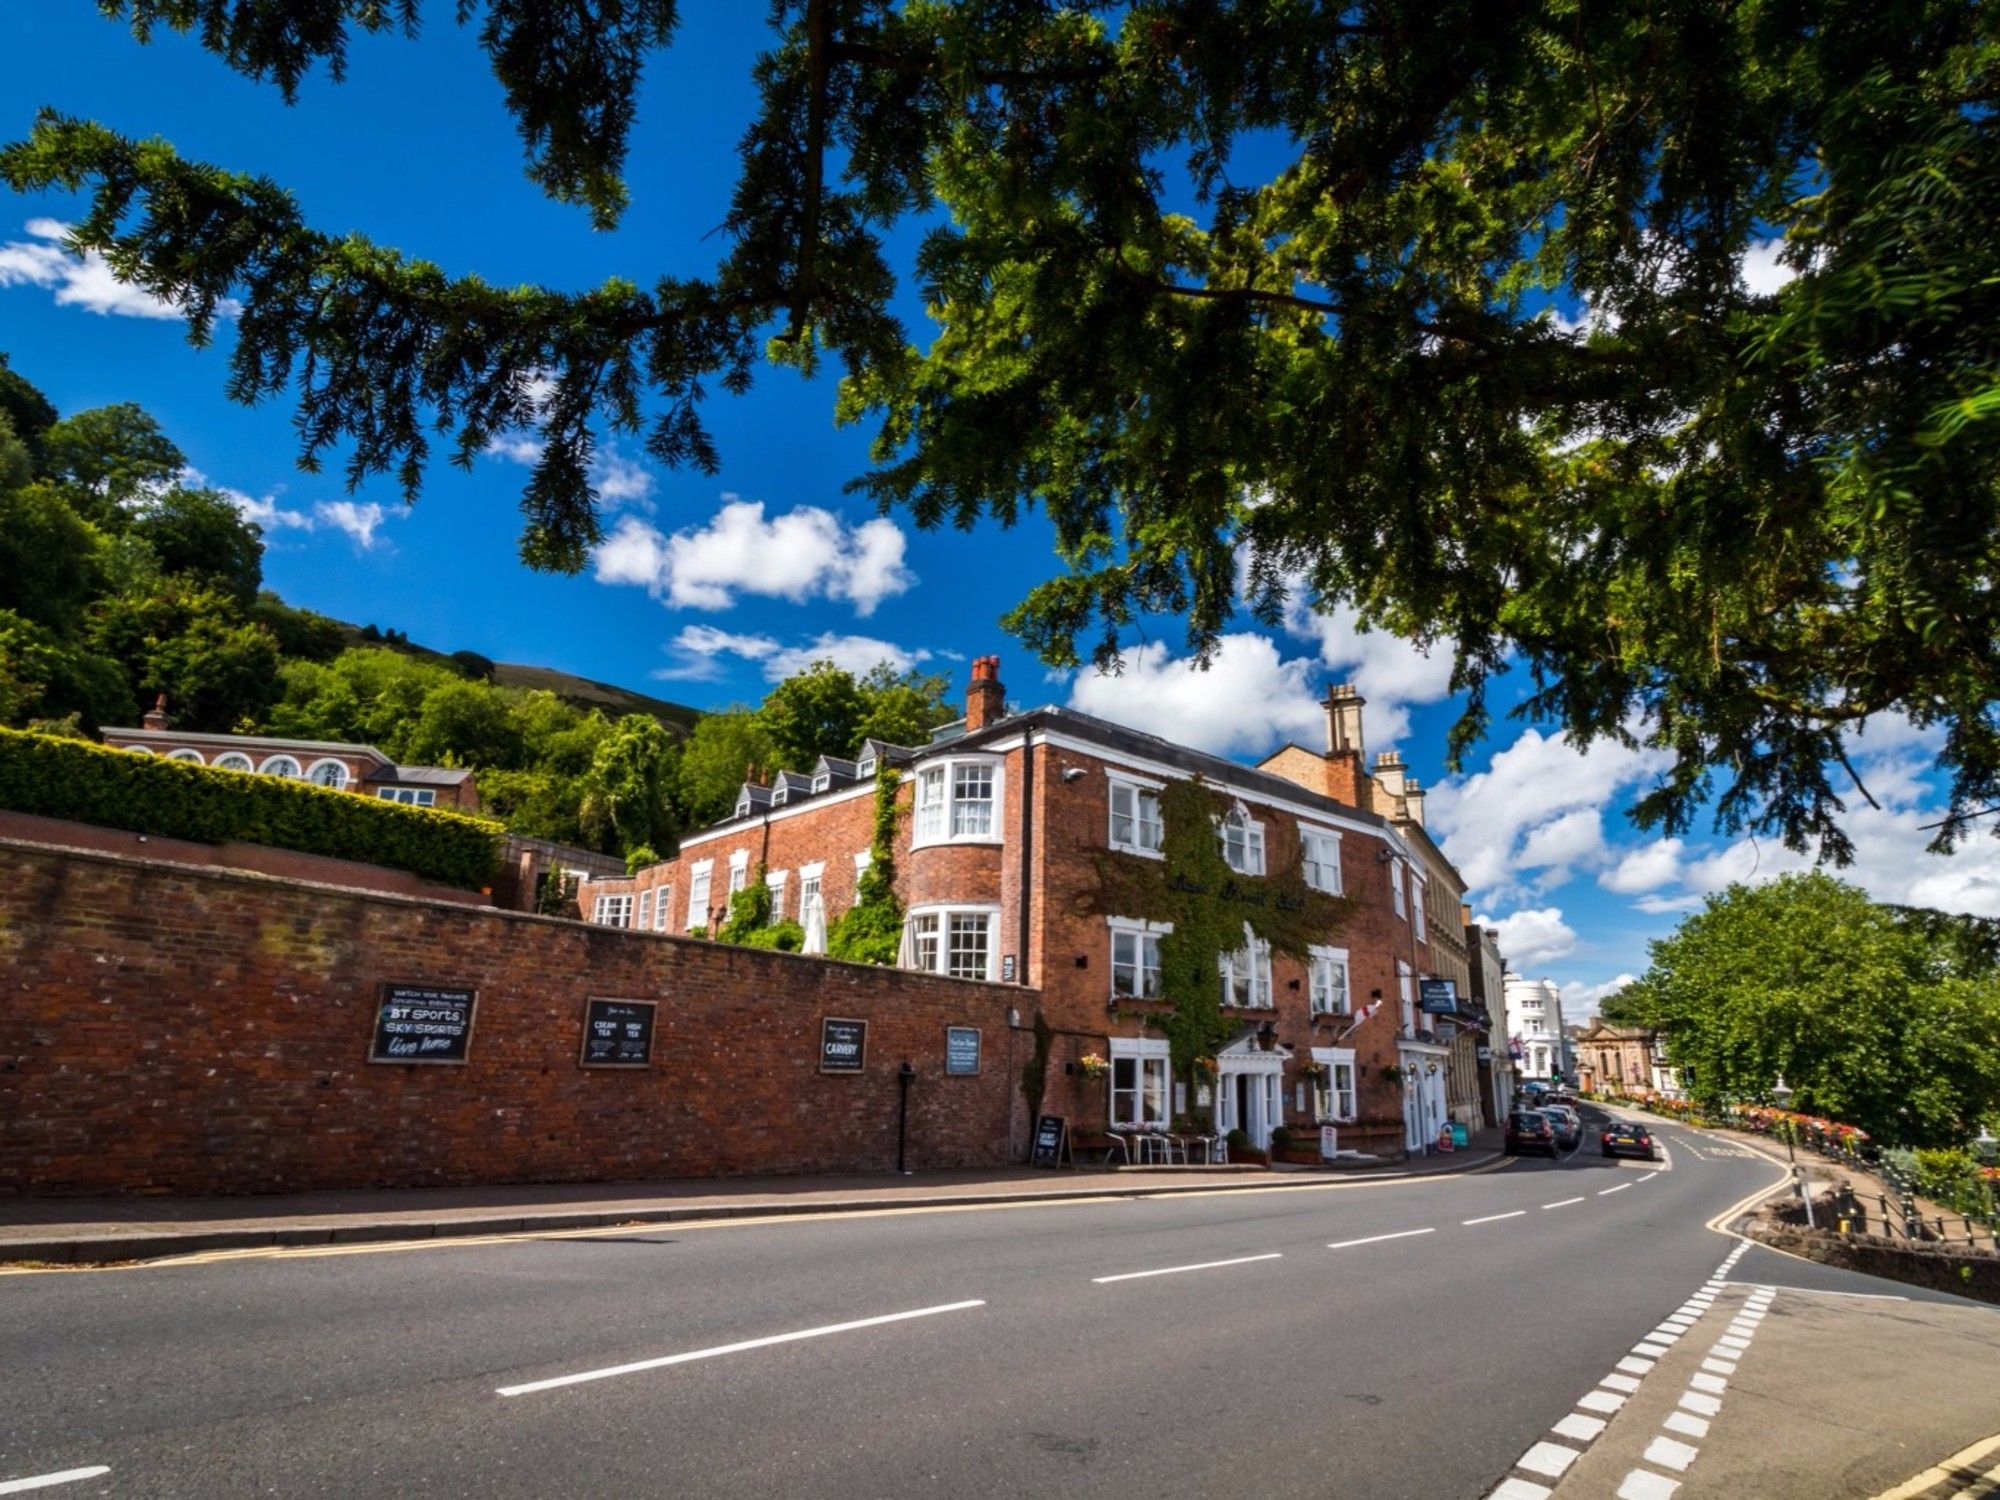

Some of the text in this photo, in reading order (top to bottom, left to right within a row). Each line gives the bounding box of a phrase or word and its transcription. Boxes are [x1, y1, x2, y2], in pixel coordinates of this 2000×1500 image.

[390, 1008, 410, 1019] BT
[386, 1022, 463, 1035] SKY SPORTS
